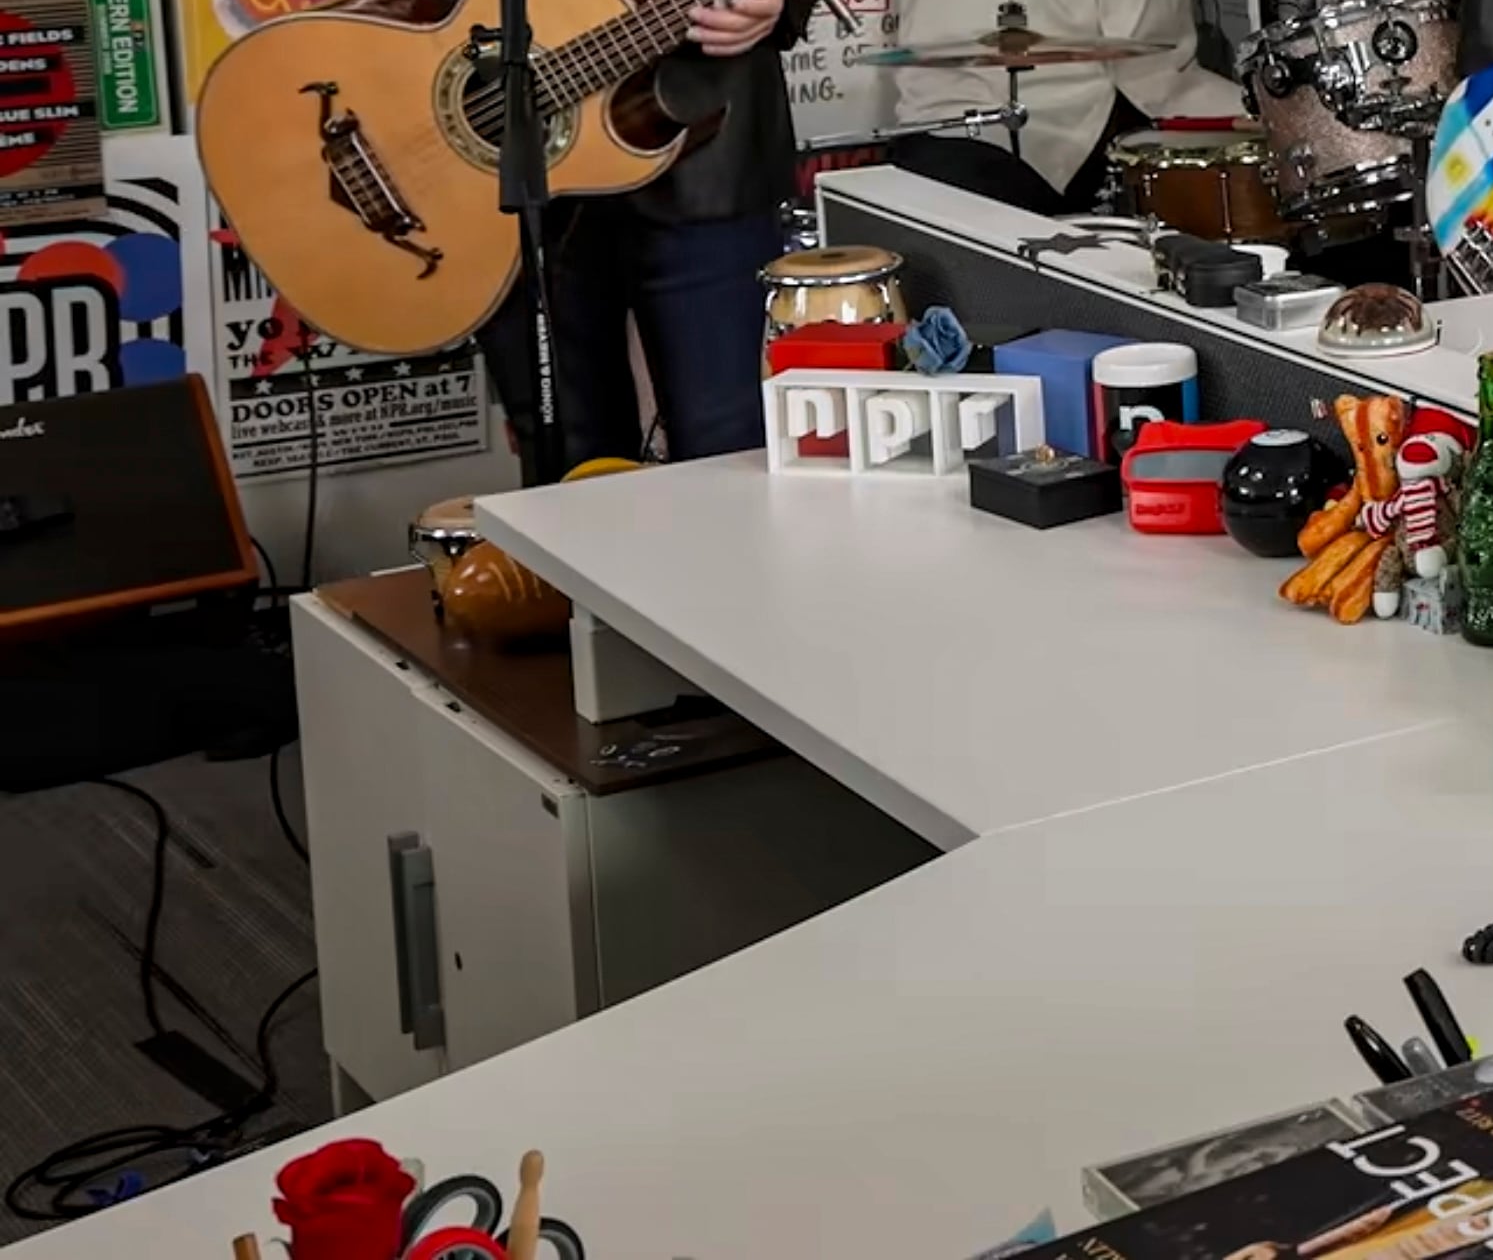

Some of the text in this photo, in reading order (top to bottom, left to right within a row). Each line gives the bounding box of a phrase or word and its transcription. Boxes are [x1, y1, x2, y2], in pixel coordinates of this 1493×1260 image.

[8, 29, 73, 45] FIELDS
[113, 35, 139, 114] EDITION
[34, 106, 79, 120] SLIM
[232, 375, 473, 423] DOORS OPEN at 7
[232, 395, 478, 440] live more at NPR.org/music
[787, 387, 1003, 464] npr
